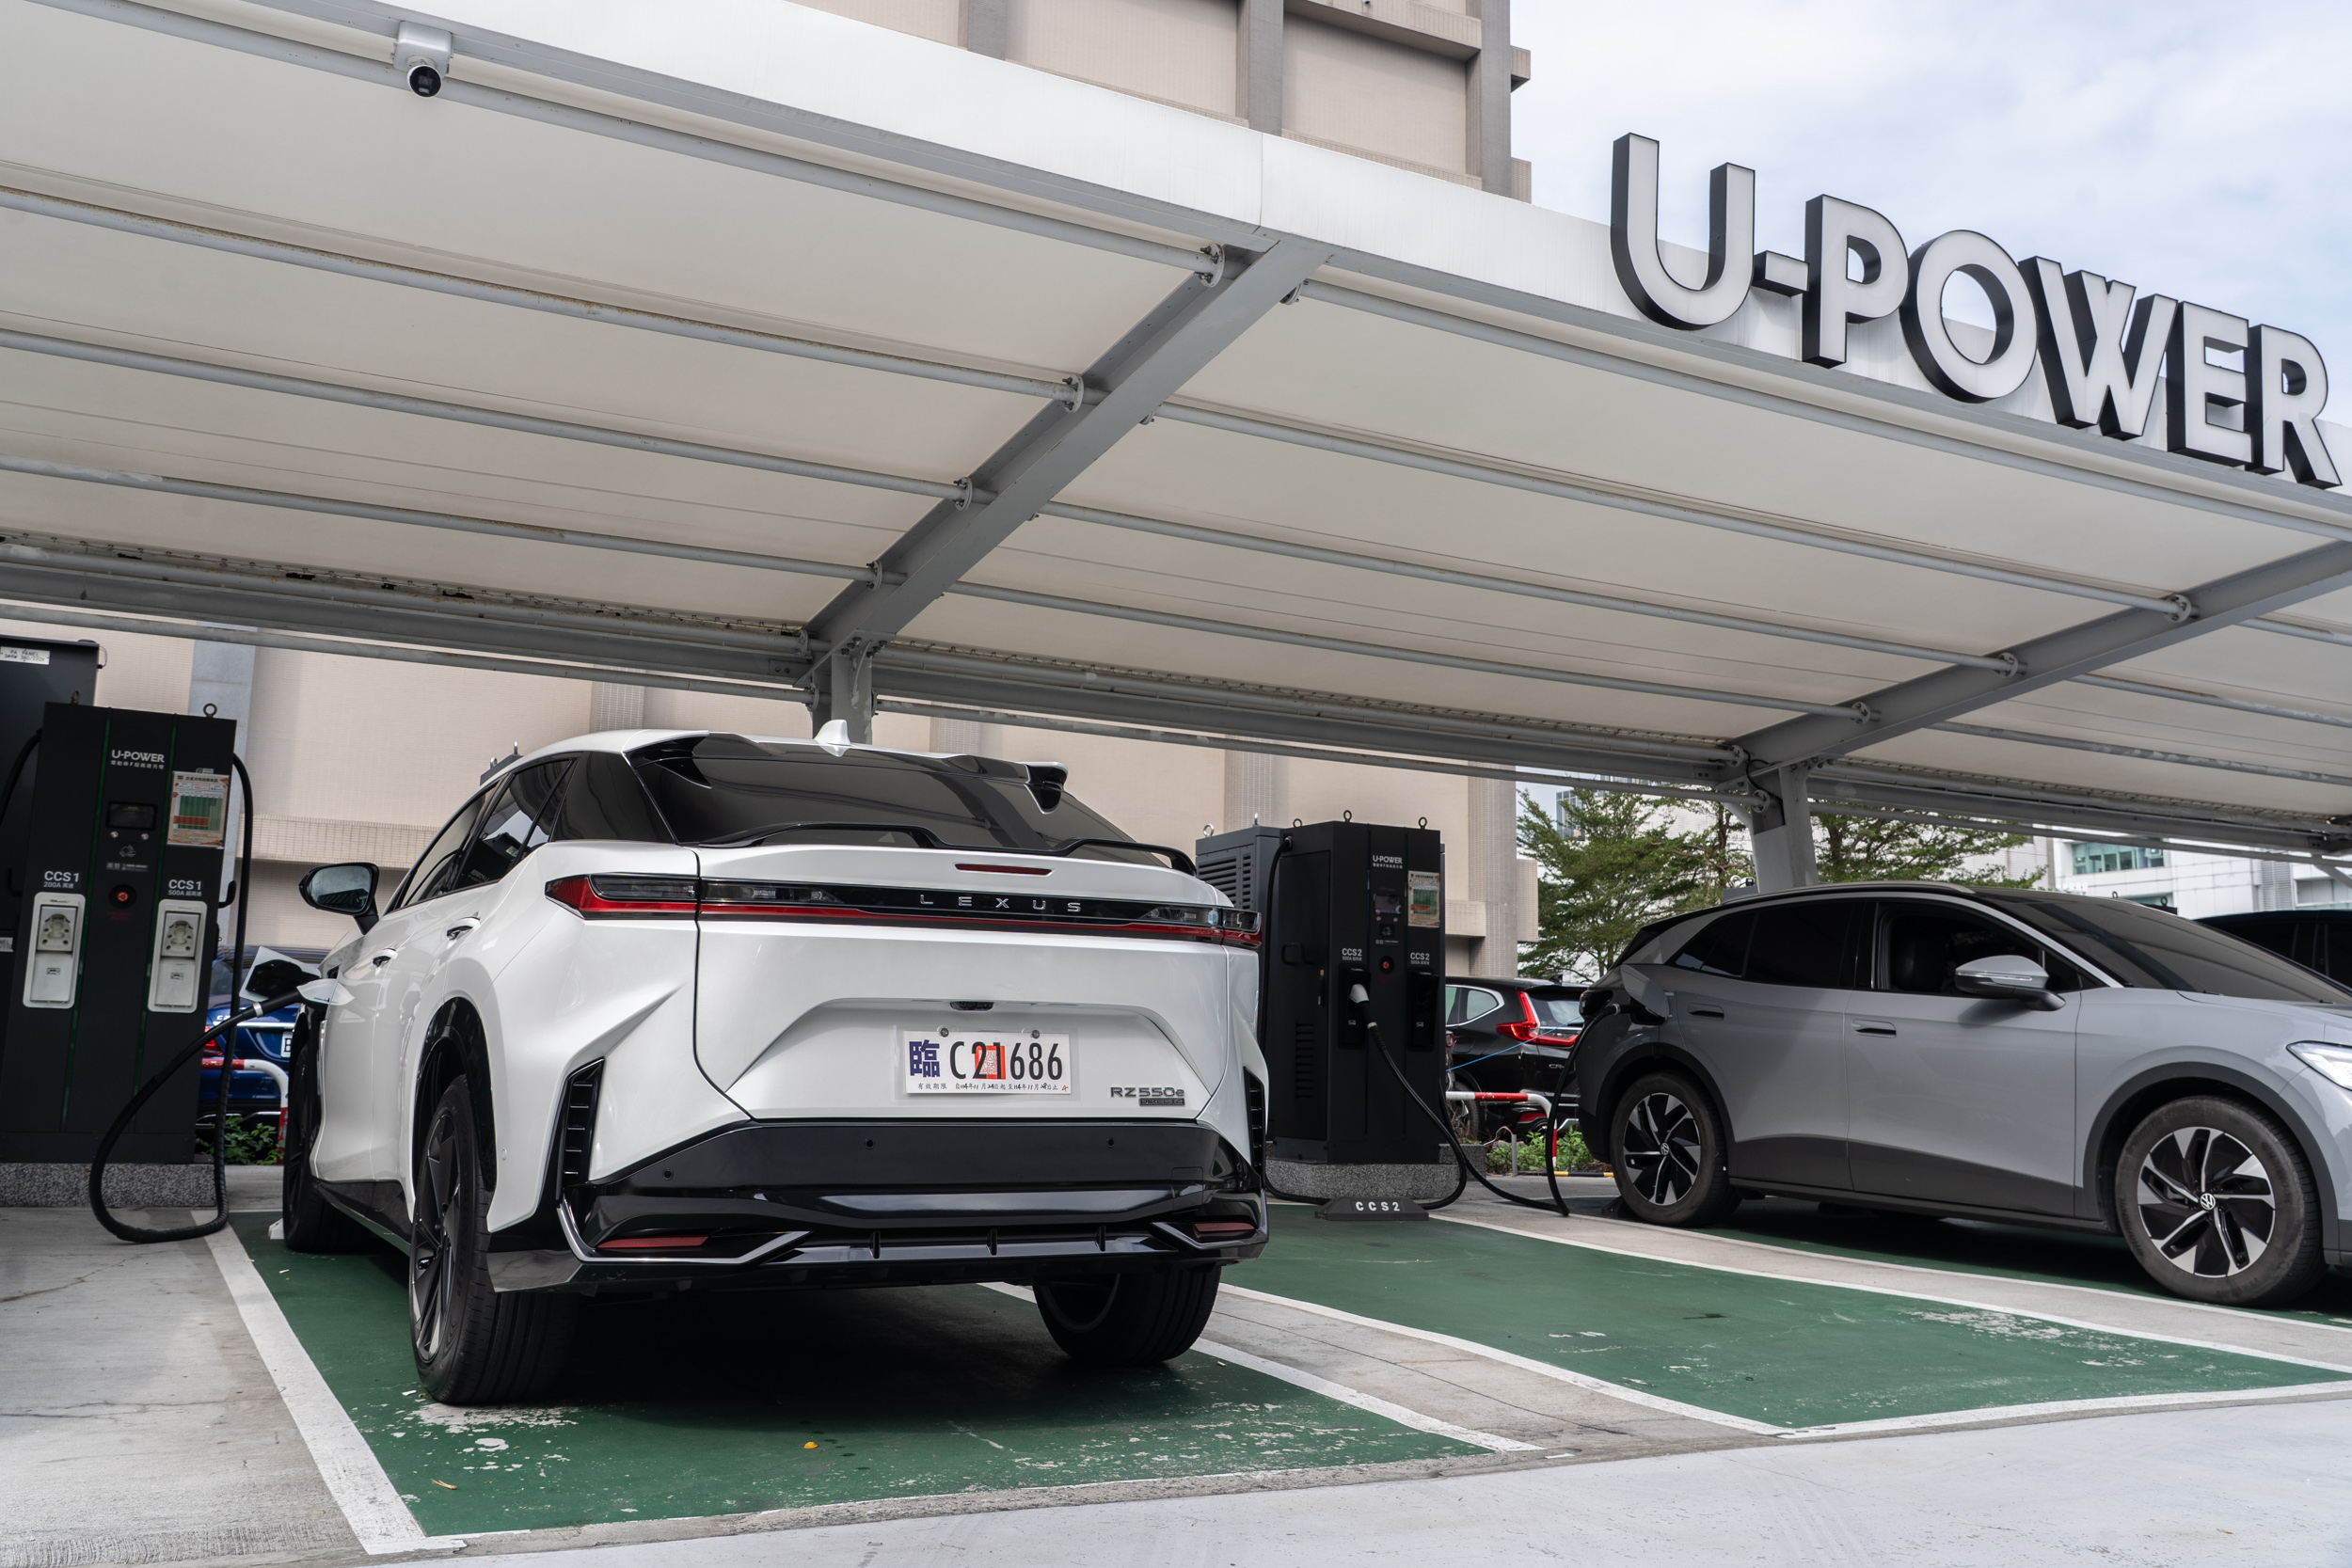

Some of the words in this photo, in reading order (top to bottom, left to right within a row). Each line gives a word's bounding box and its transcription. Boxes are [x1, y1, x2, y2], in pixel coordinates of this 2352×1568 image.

[1611, 133, 2343, 492] U-POWER
[111, 749, 165, 763] U-POWER
[1373, 855, 1403, 864] U-POWER
[920, 894, 1082, 912] LEXUS
[909, 1039, 941, 1078] 臨
[1355, 1201, 1401, 1212] CCS2
